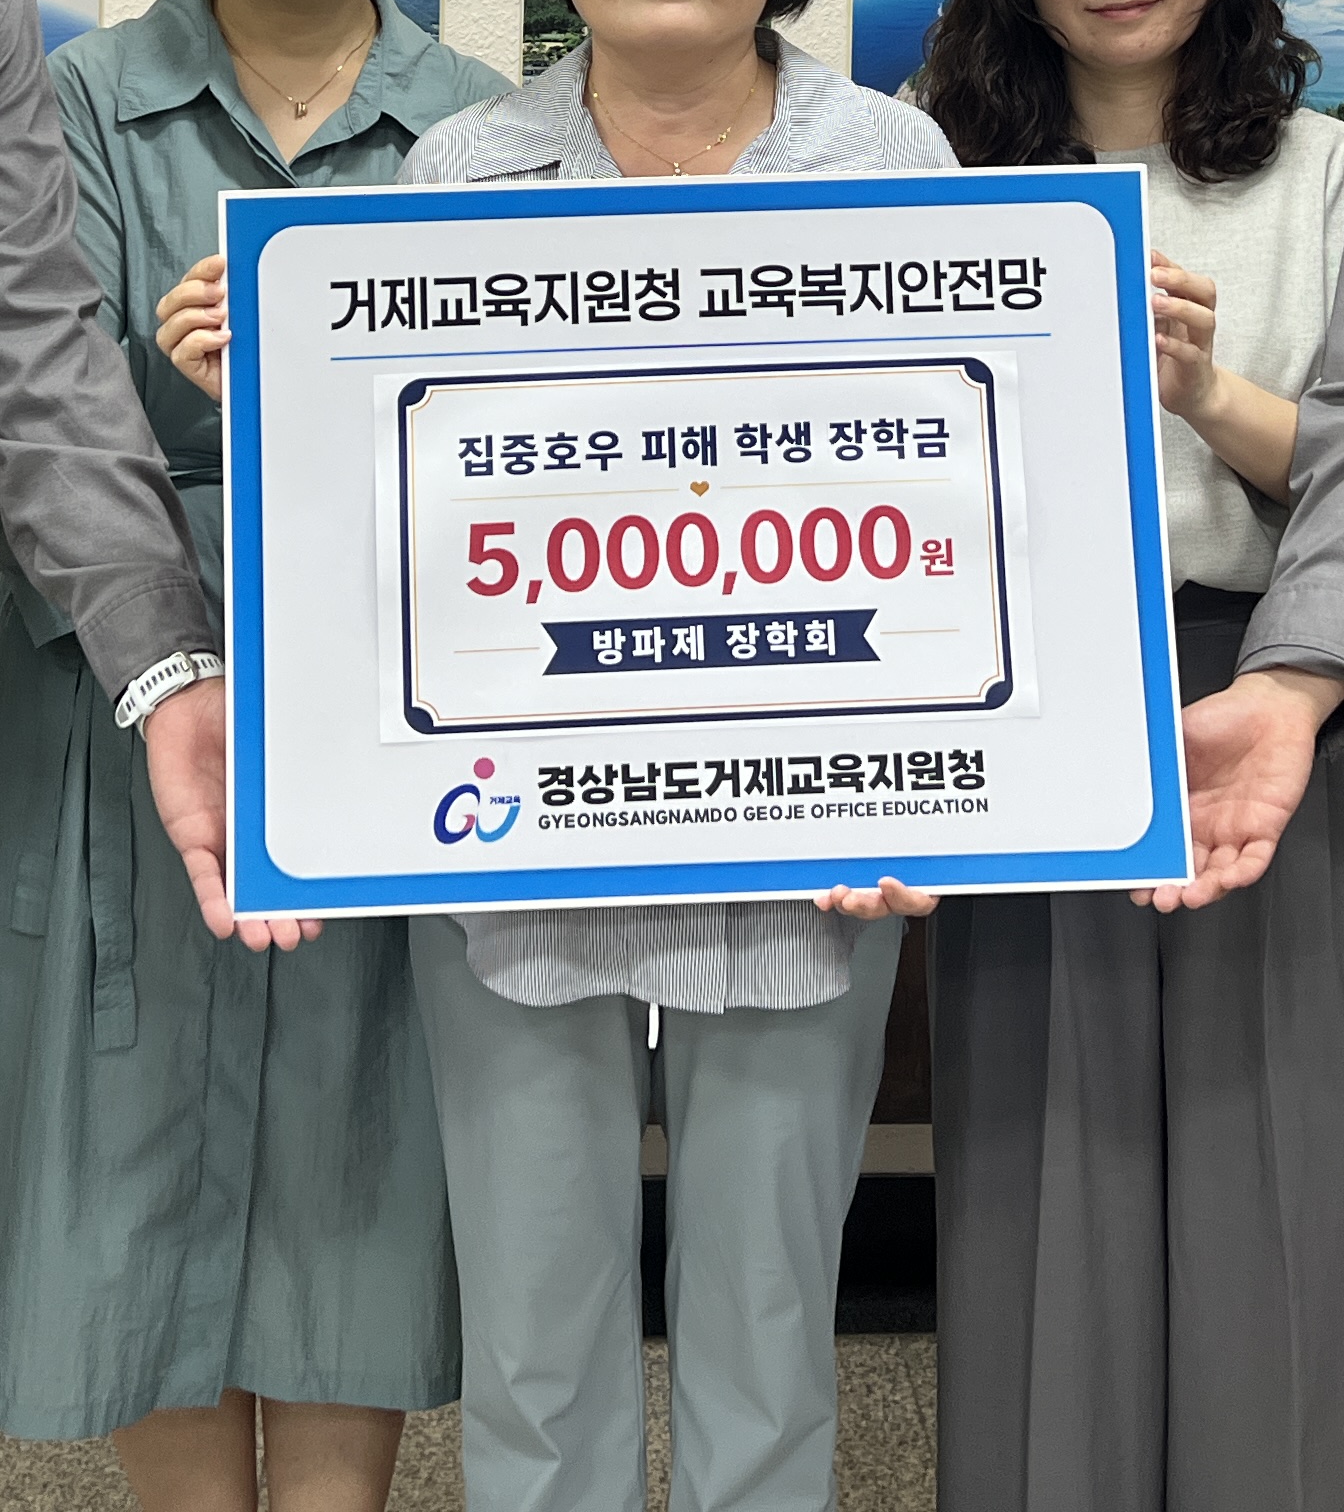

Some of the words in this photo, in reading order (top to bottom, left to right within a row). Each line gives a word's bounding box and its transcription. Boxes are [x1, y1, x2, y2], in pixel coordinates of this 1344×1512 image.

[330, 267, 681, 333] 거제교육지원청
[699, 257, 1046, 322] 교육복지안전망
[458, 432, 623, 477] 집중호우
[641, 423, 719, 469] 피해
[735, 420, 814, 463] 학생
[829, 415, 951, 461] 장학금
[592, 623, 706, 665] 방파제
[725, 617, 837, 660] 장학회
[537, 749, 986, 806] 경상남도거제교육지원청
[538, 806, 738, 830] GYEONGSANGNAMDO
[743, 804, 805, 822] GEOJE
[810, 801, 878, 819] OFFICE
[882, 797, 989, 816] EDUCATION
